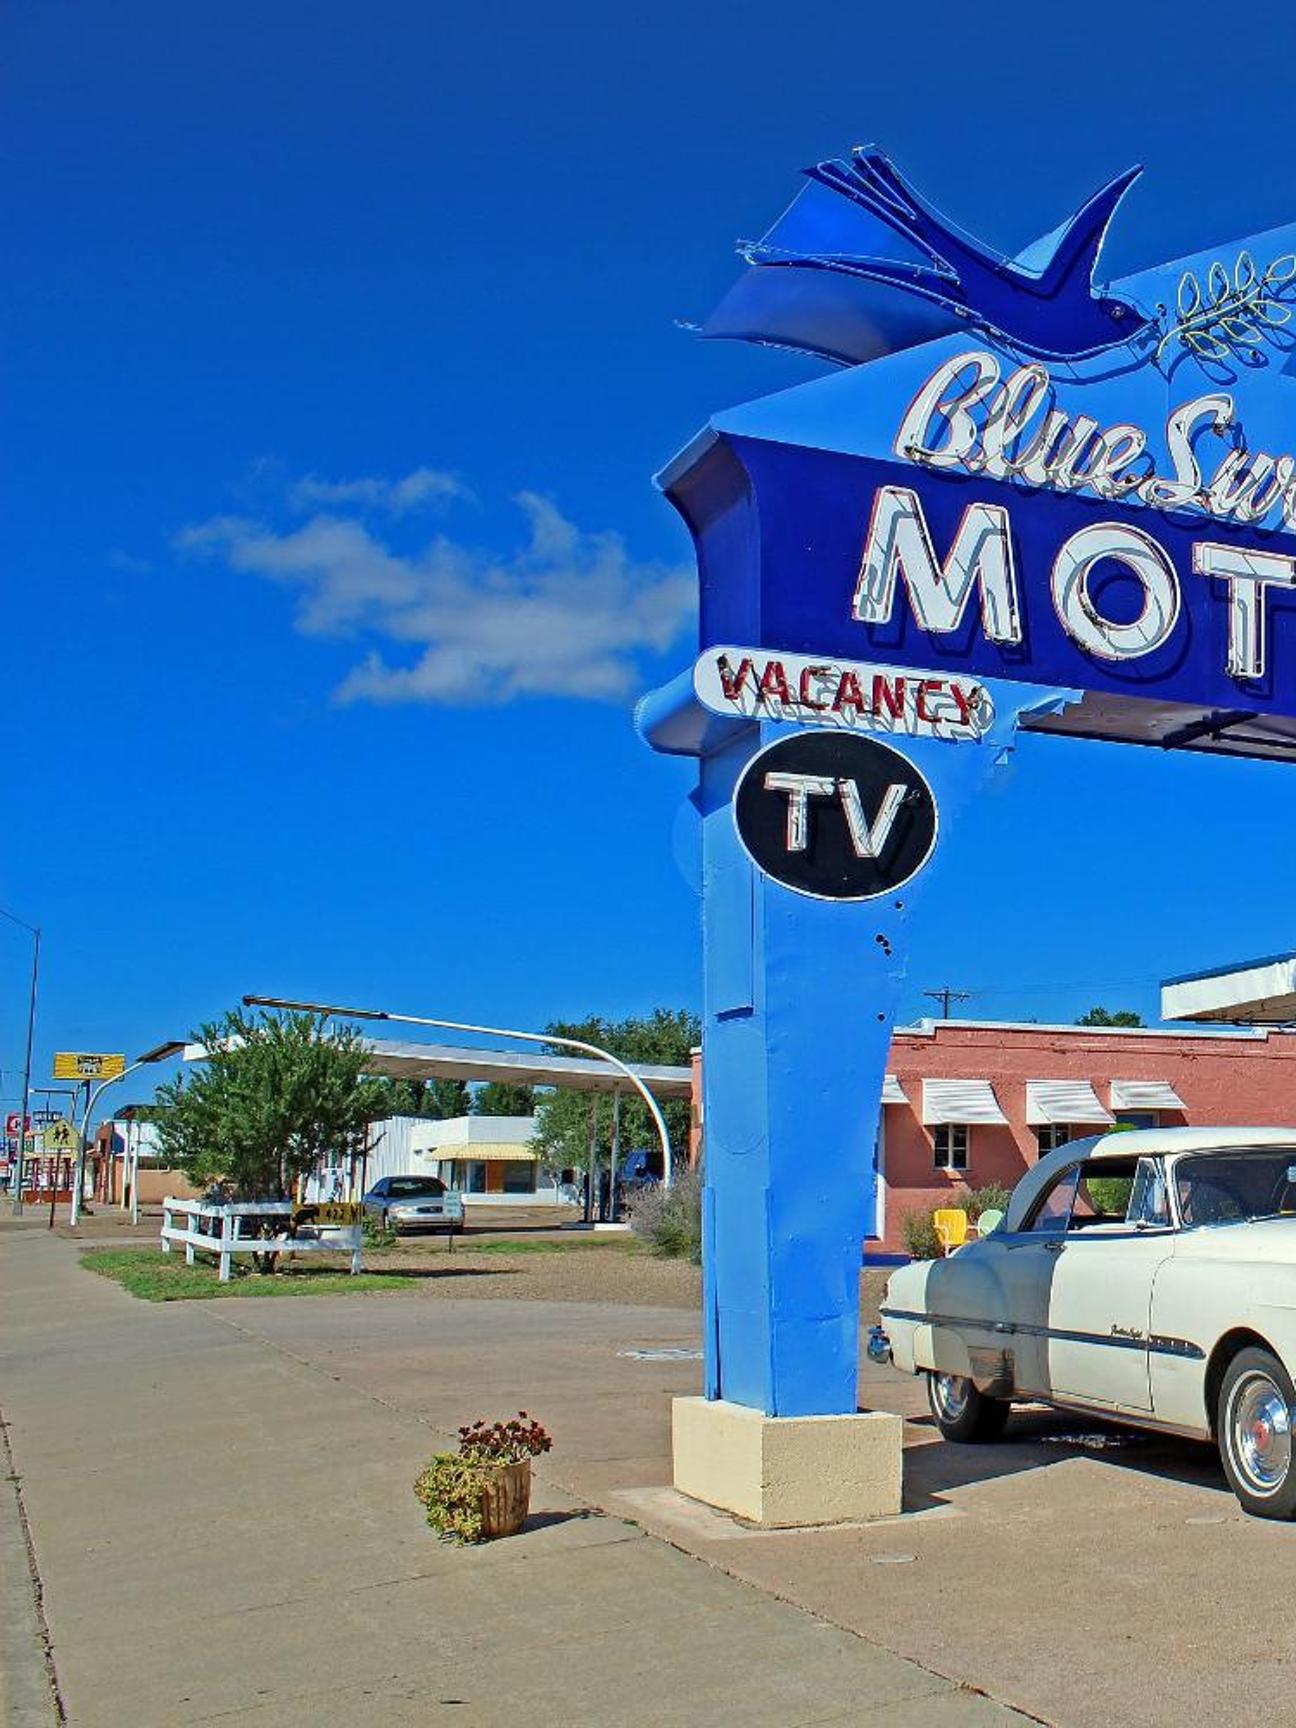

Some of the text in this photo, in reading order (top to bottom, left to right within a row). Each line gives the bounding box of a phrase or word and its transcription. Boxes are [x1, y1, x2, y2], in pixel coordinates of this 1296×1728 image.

[893, 351, 1152, 497] Blue
[717, 652, 985, 727] VACANCY
[764, 771, 909, 859] TV
